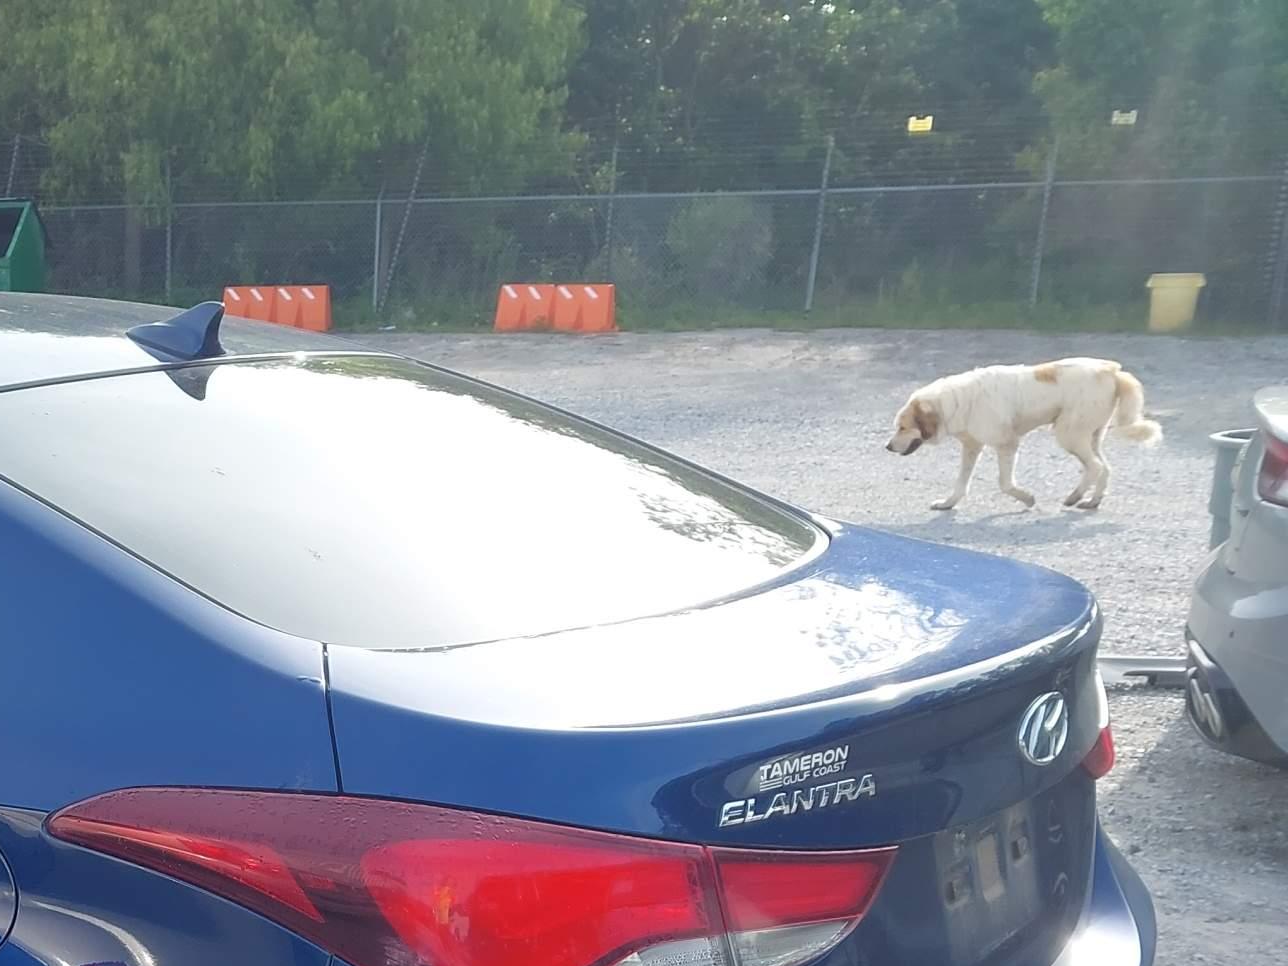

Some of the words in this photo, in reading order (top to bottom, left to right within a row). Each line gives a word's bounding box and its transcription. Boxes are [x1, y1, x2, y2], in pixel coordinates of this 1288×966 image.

[760, 745, 849, 779] TAMERON
[783, 773, 811, 785] GULF
[813, 761, 847, 777] COAST
[719, 774, 876, 827] ELANTRA
